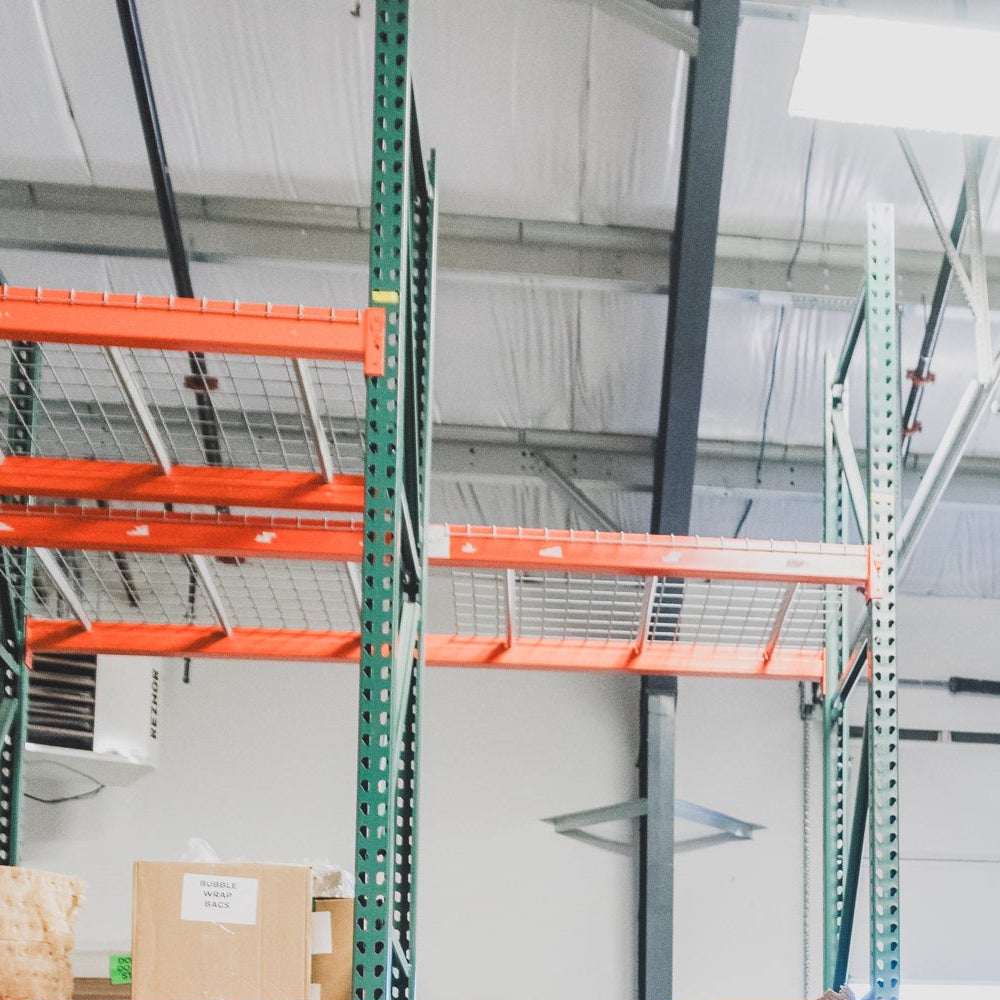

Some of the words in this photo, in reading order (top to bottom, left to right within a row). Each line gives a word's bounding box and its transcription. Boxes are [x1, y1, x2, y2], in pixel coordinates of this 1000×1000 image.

[199, 880, 237, 890] BUBBLE
[203, 890, 233, 900] WRAP
[204, 900, 230, 909] BAGS
